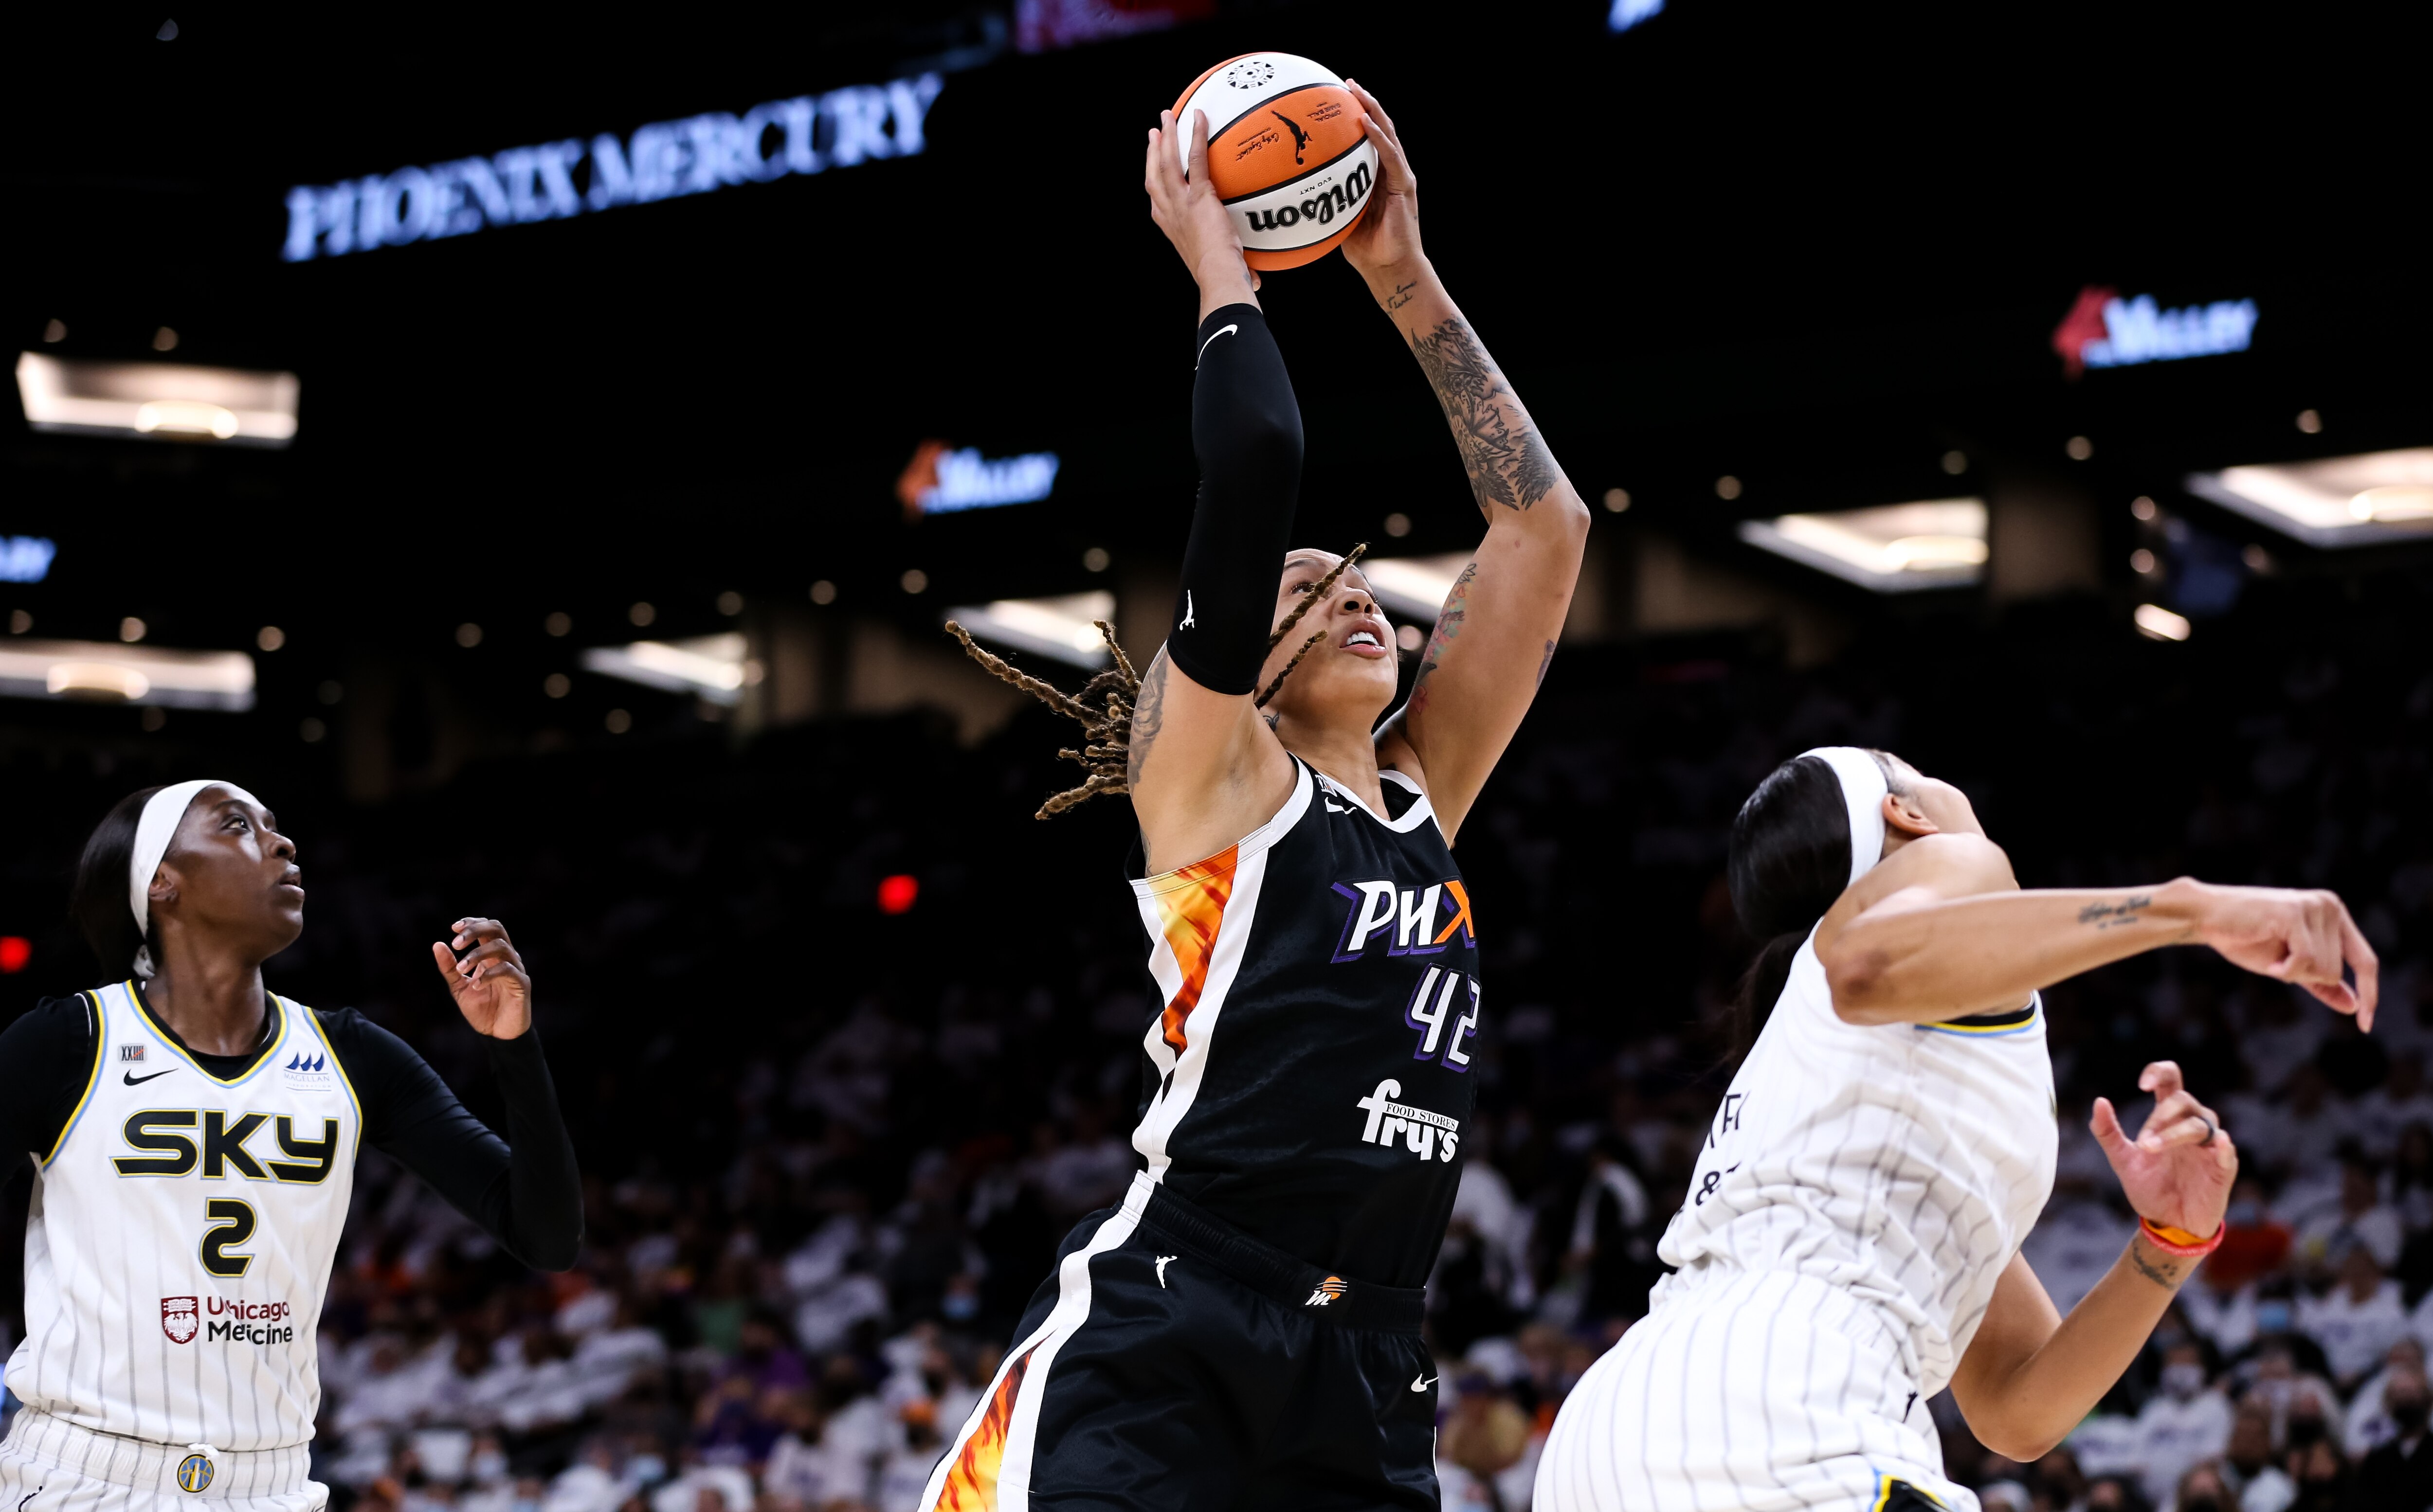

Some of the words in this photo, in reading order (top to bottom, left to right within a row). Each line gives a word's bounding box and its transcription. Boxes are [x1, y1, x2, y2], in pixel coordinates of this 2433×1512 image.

[282, 138, 585, 263] PHOENIX
[585, 72, 944, 211] MERCURY
[1245, 161, 1372, 232] Wilson
[1300, 185, 1315, 195] NXT
[1317, 176, 1332, 187] EVO
[1330, 879, 1476, 963] PHX
[1405, 963, 1482, 1073] 42
[284, 1072, 330, 1082] MAGELLAN
[109, 1108, 340, 1186] SKY
[1357, 1079, 1459, 1163] fry's
[1386, 1103, 1415, 1118] FOOD
[1419, 1111, 1456, 1130] STORES
[199, 1196, 257, 1278] 2
